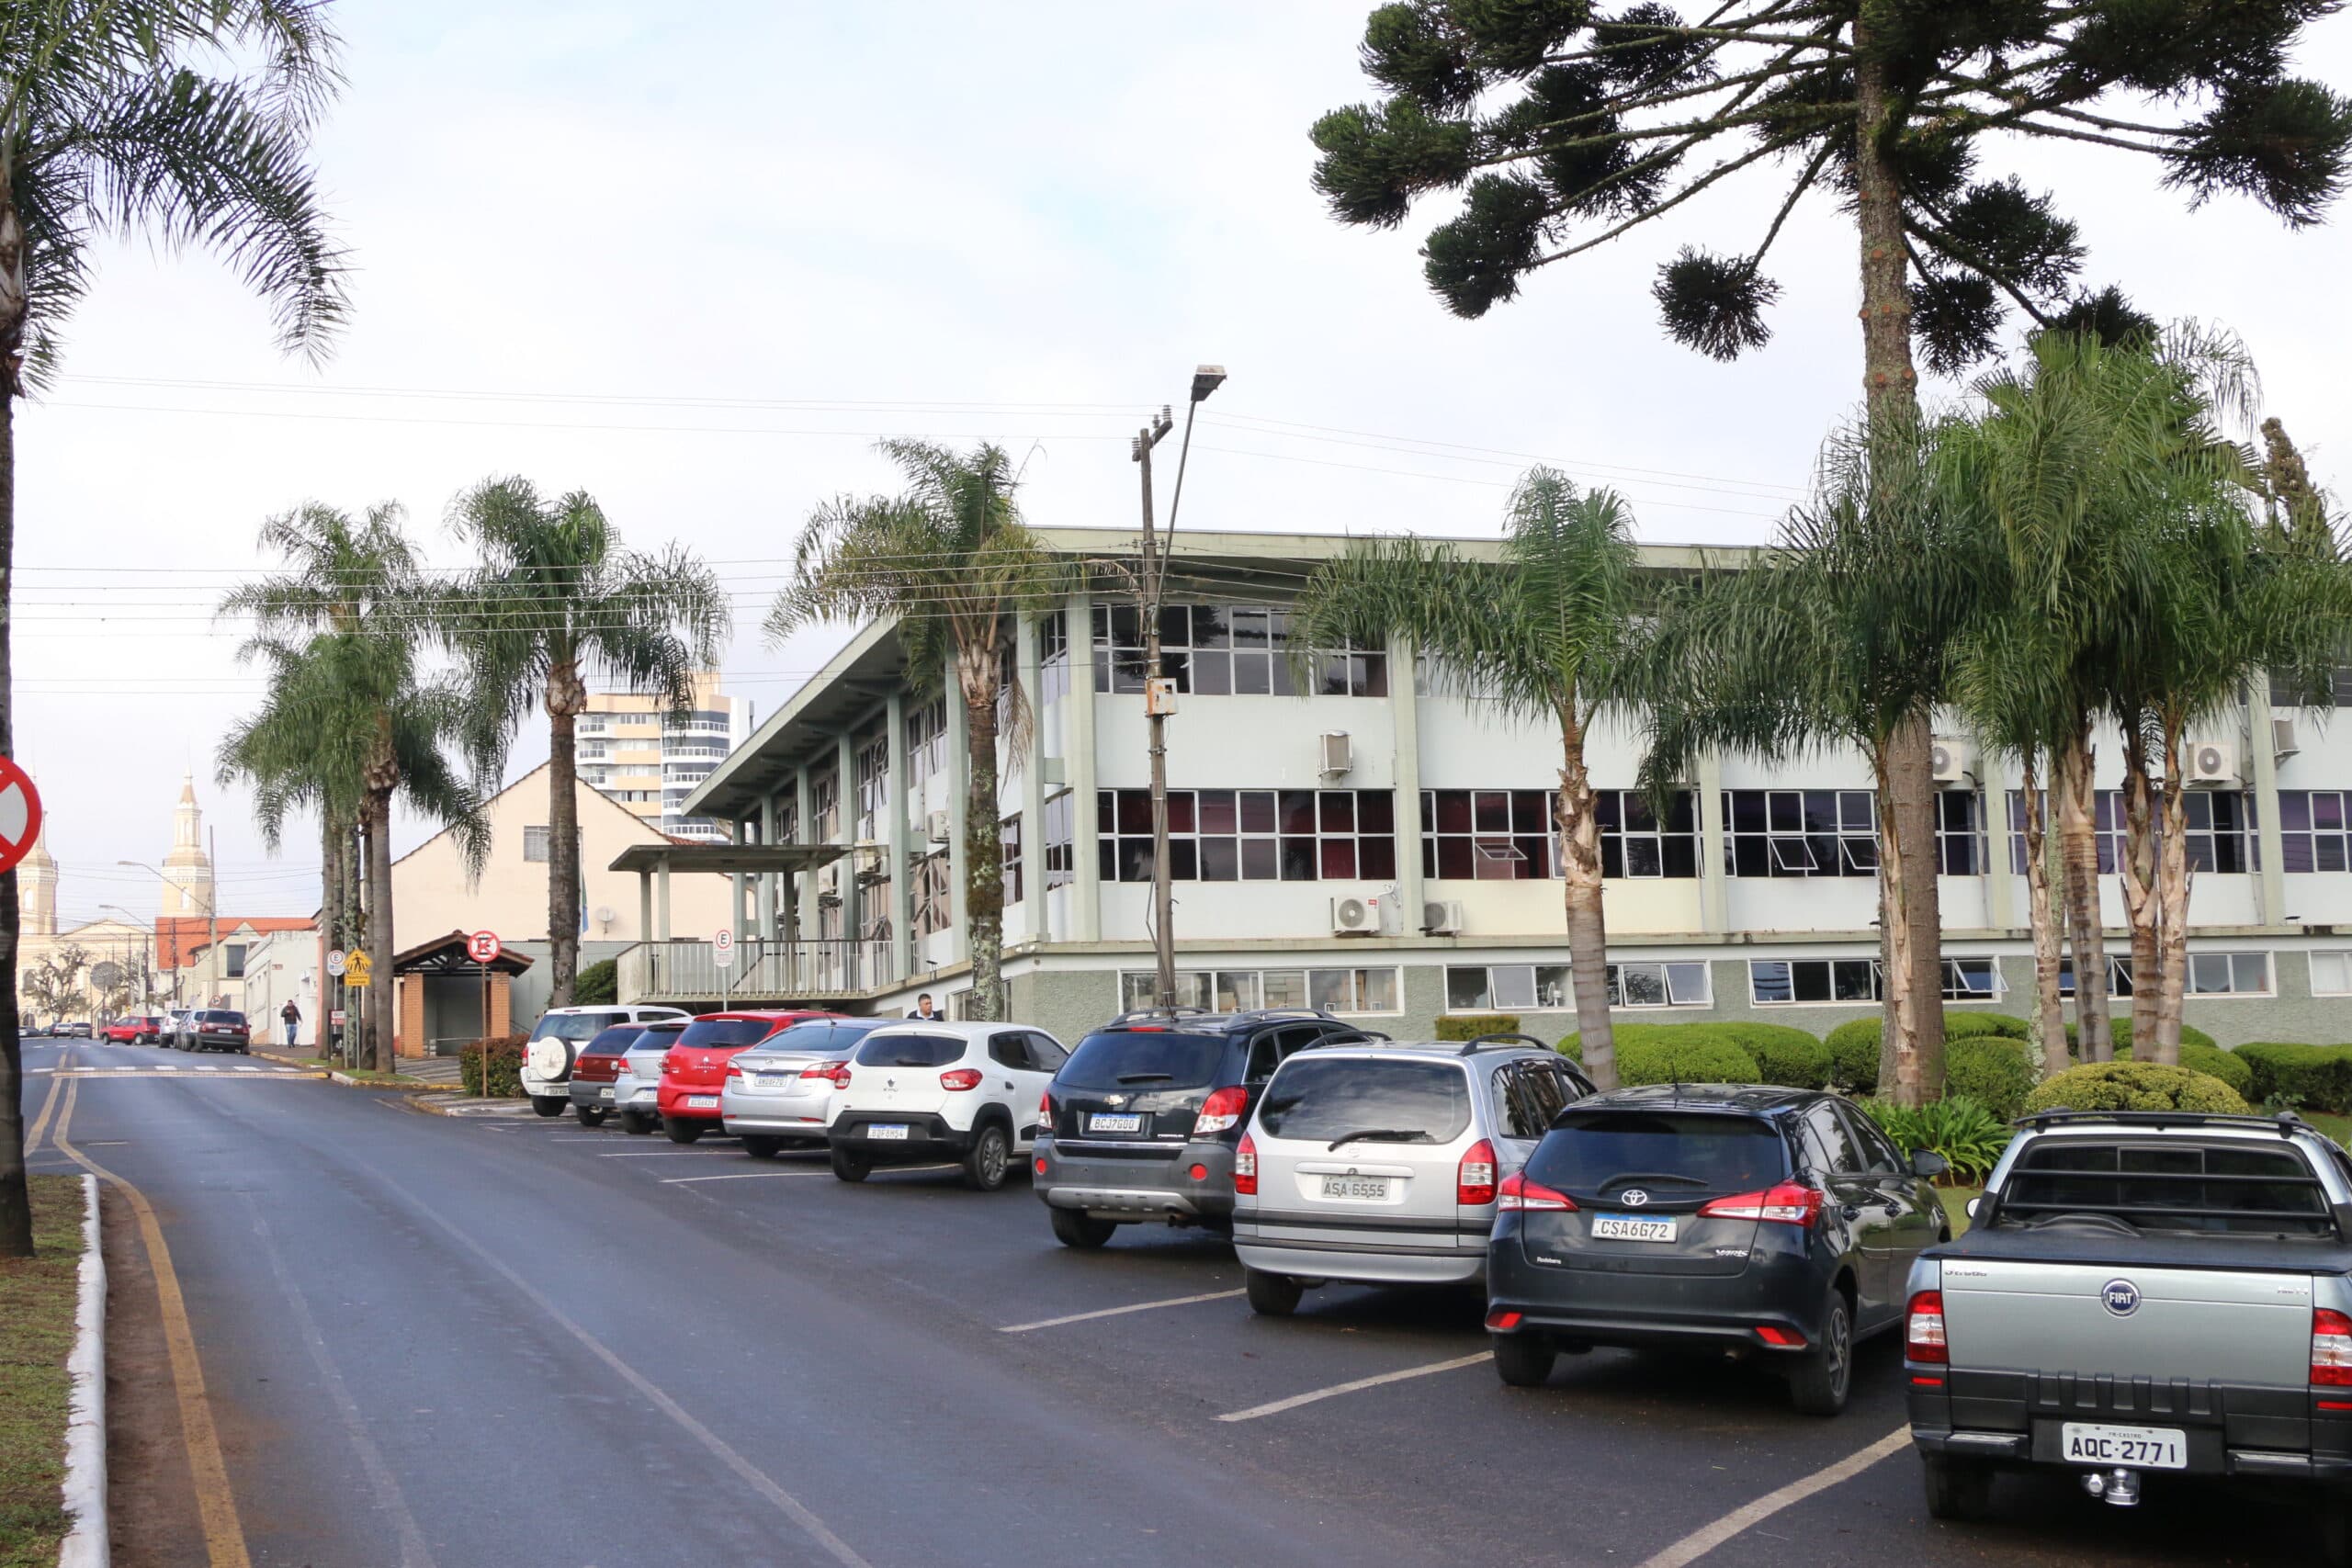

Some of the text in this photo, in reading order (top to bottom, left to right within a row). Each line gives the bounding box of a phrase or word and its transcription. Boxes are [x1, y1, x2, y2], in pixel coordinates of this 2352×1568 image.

[720, 933, 727, 944] E
[1600, 1221, 1668, 1238] CSA6G72
[2109, 1292, 2132, 1304] FIAT
